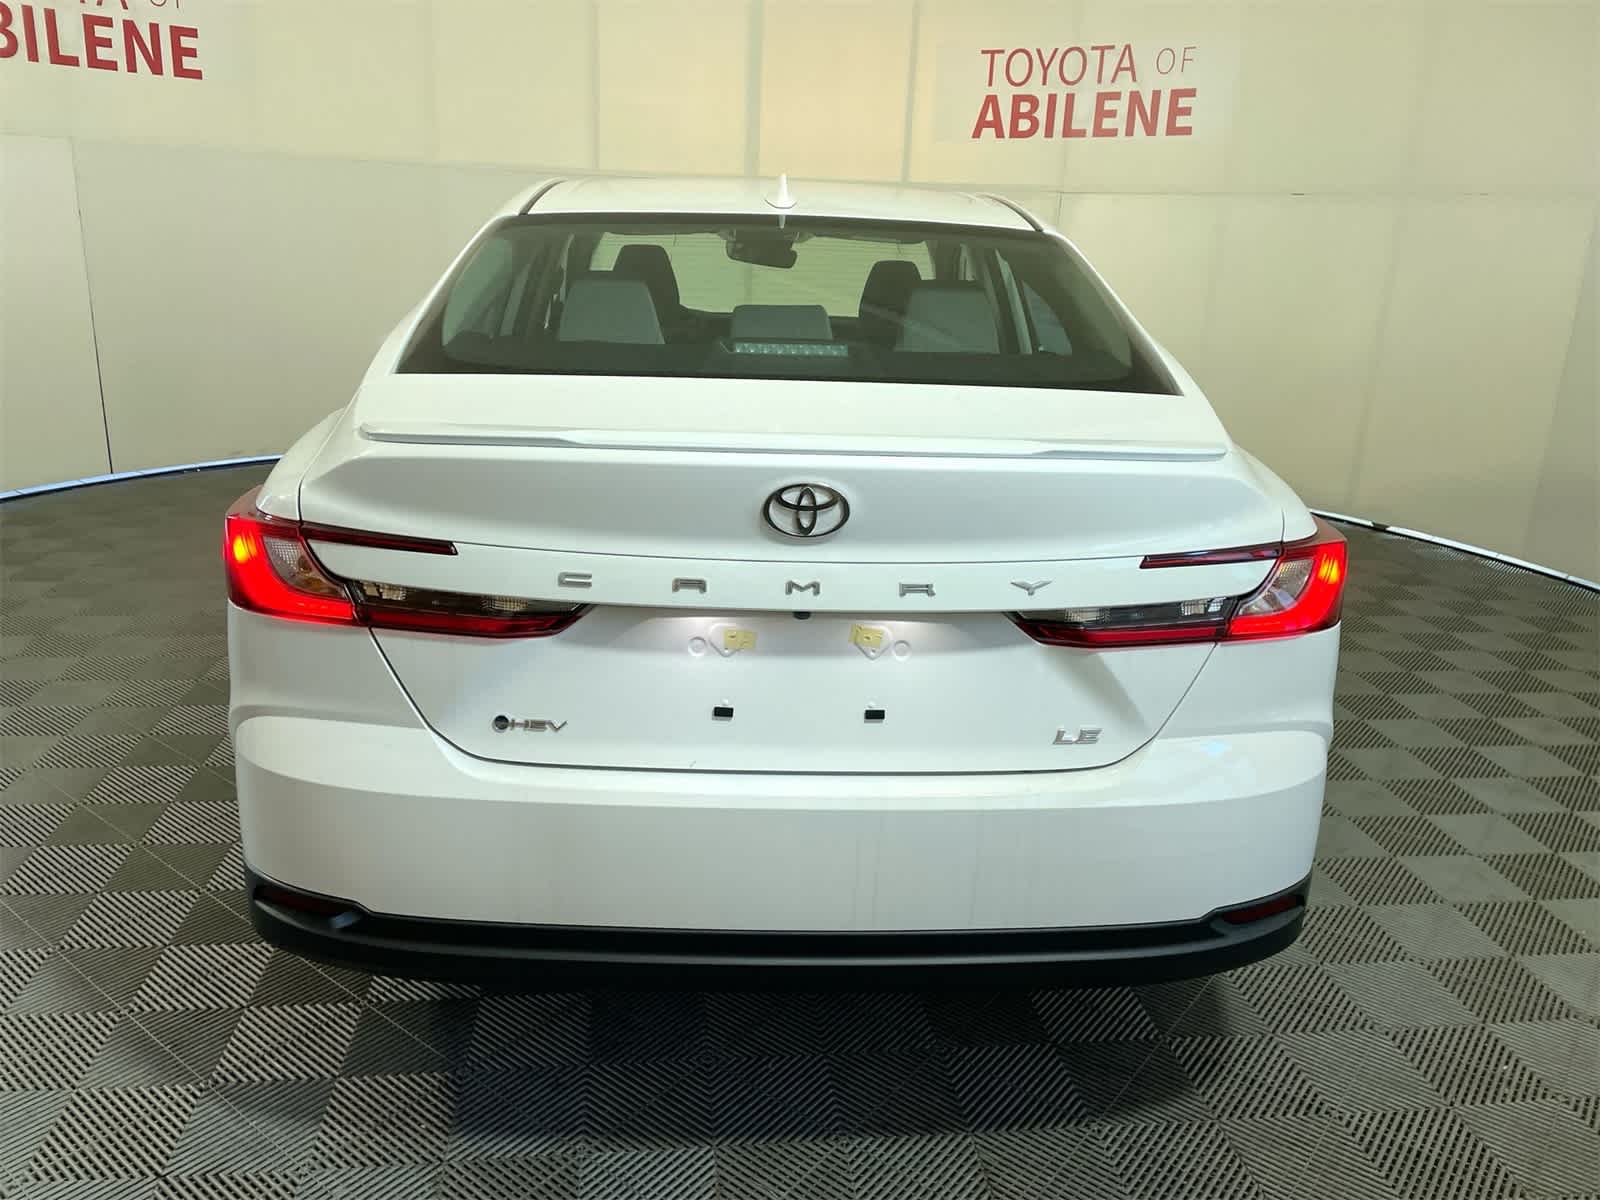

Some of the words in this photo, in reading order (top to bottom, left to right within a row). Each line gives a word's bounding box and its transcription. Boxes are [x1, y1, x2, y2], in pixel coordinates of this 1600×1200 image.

[981, 44, 1137, 87] TOYOTA
[1156, 46, 1197, 75] OF
[971, 88, 1197, 138] ABILENE
[557, 571, 1053, 597] CAMRY
[510, 718, 568, 732] HEV
[1052, 729, 1103, 745] LE
